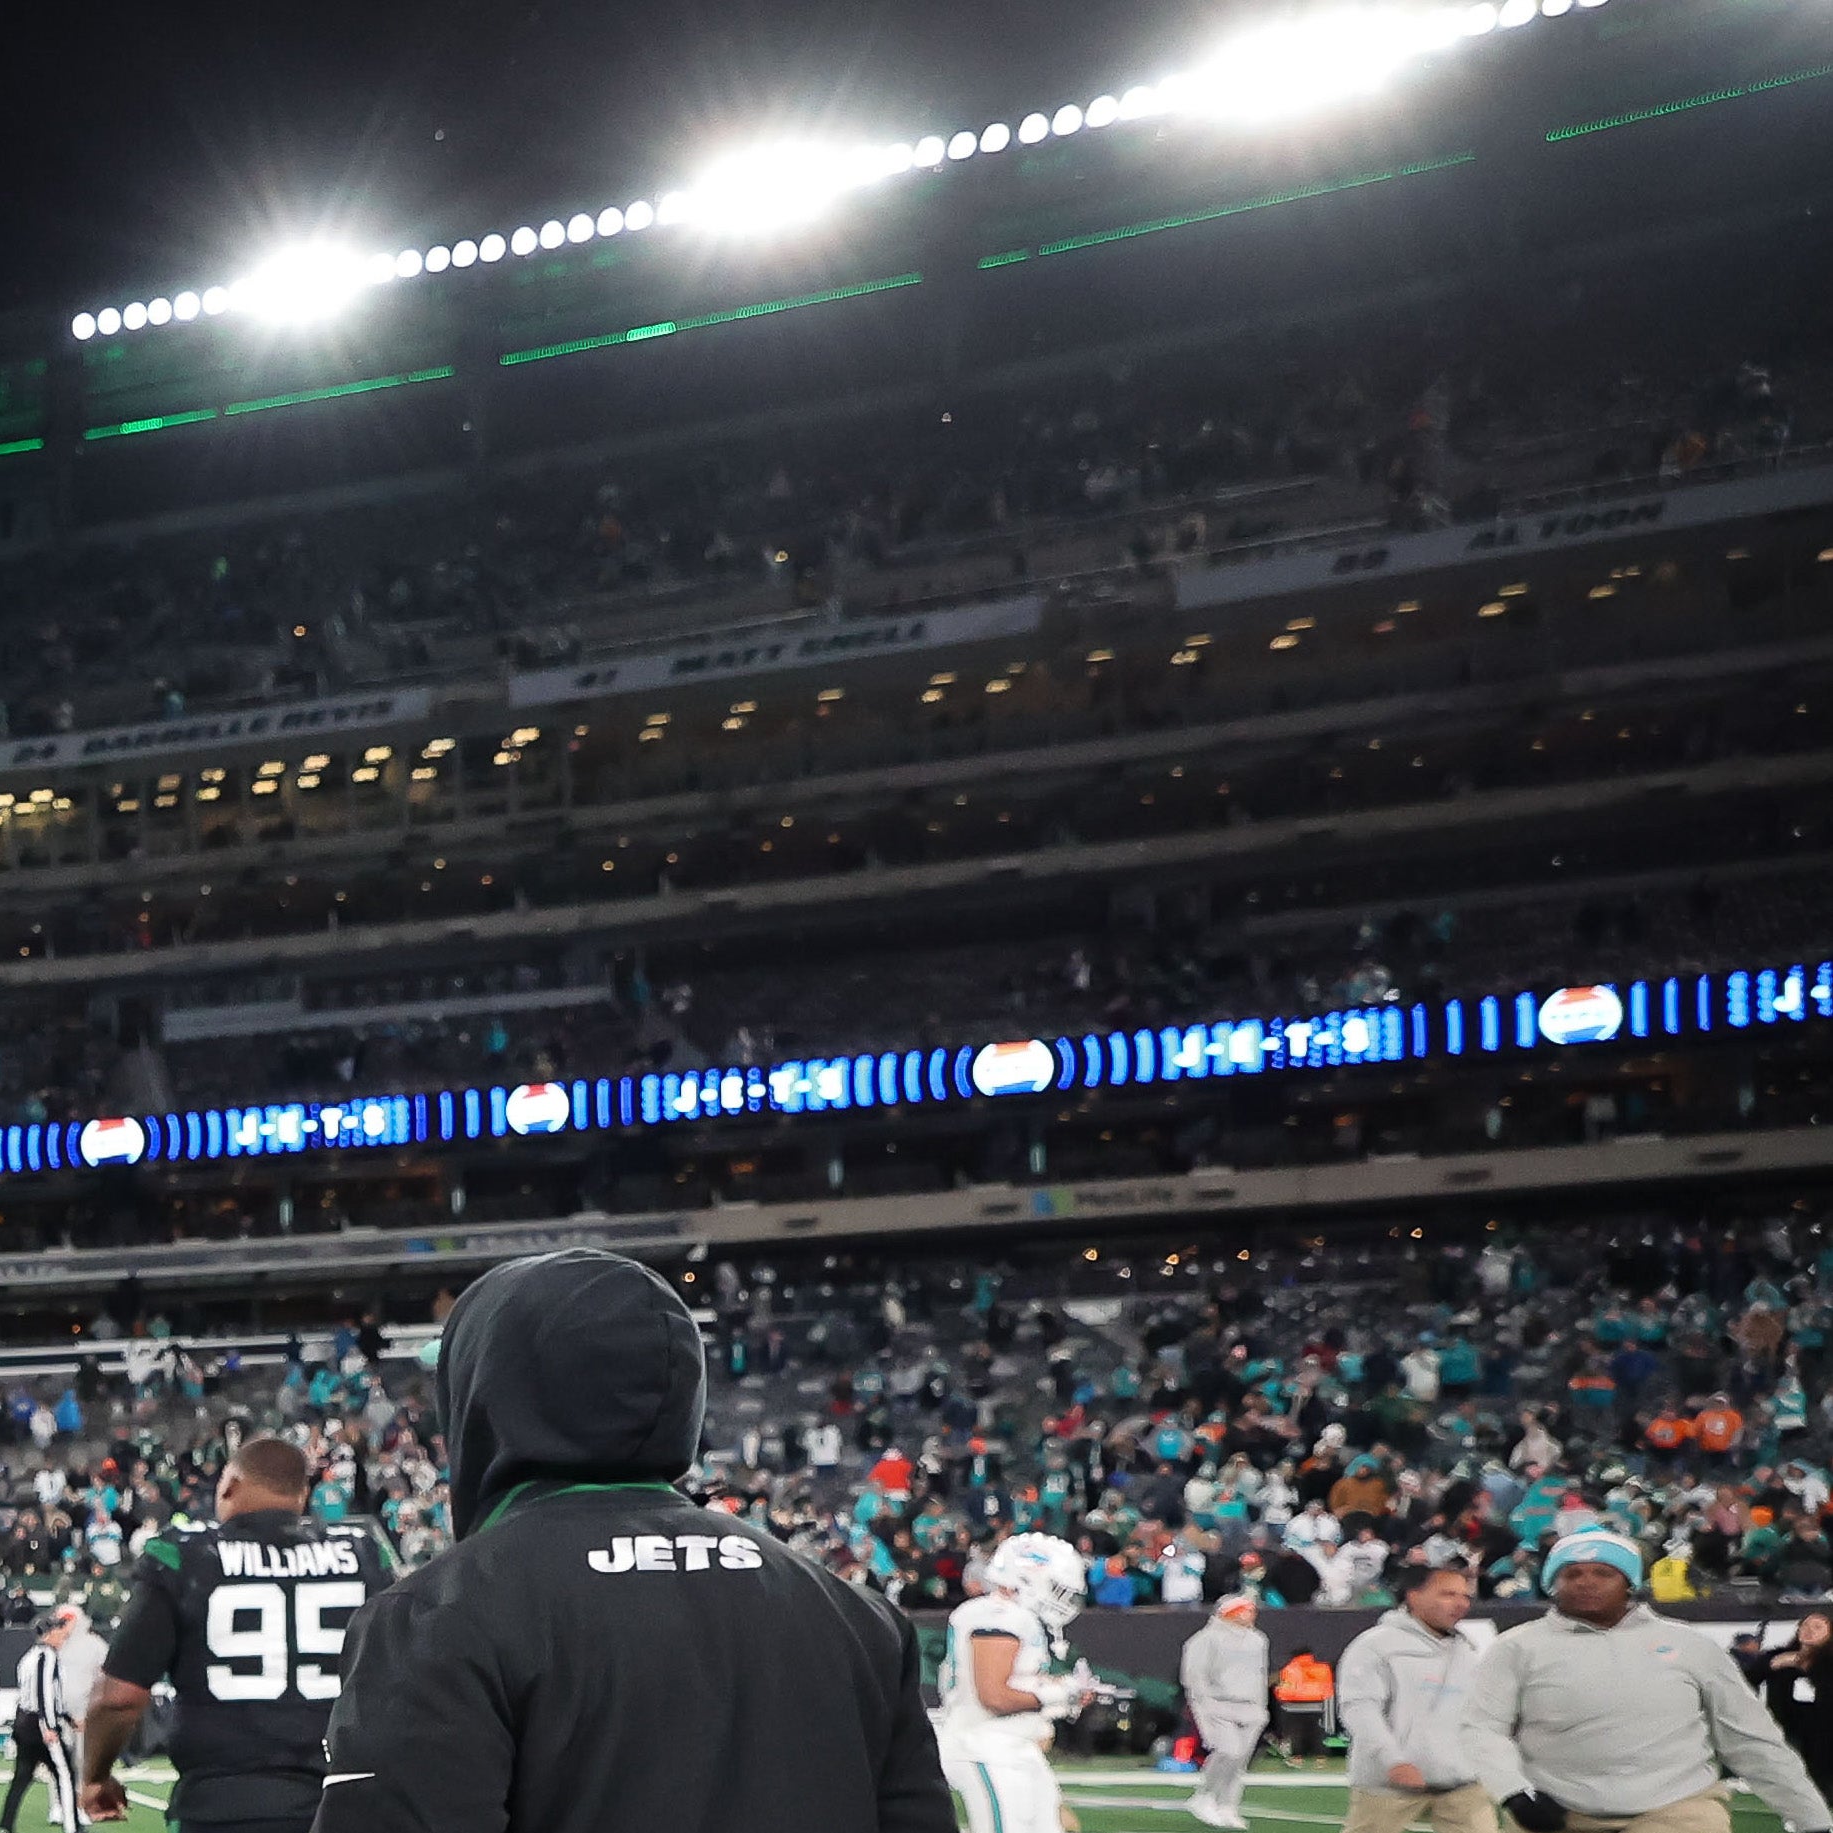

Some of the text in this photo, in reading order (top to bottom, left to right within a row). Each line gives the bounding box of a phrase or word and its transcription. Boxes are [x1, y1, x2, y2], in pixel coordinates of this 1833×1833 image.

[217, 1540, 359, 1577] WILLIAMS
[588, 1535, 763, 1573] JETS
[206, 1581, 366, 1700] 95
